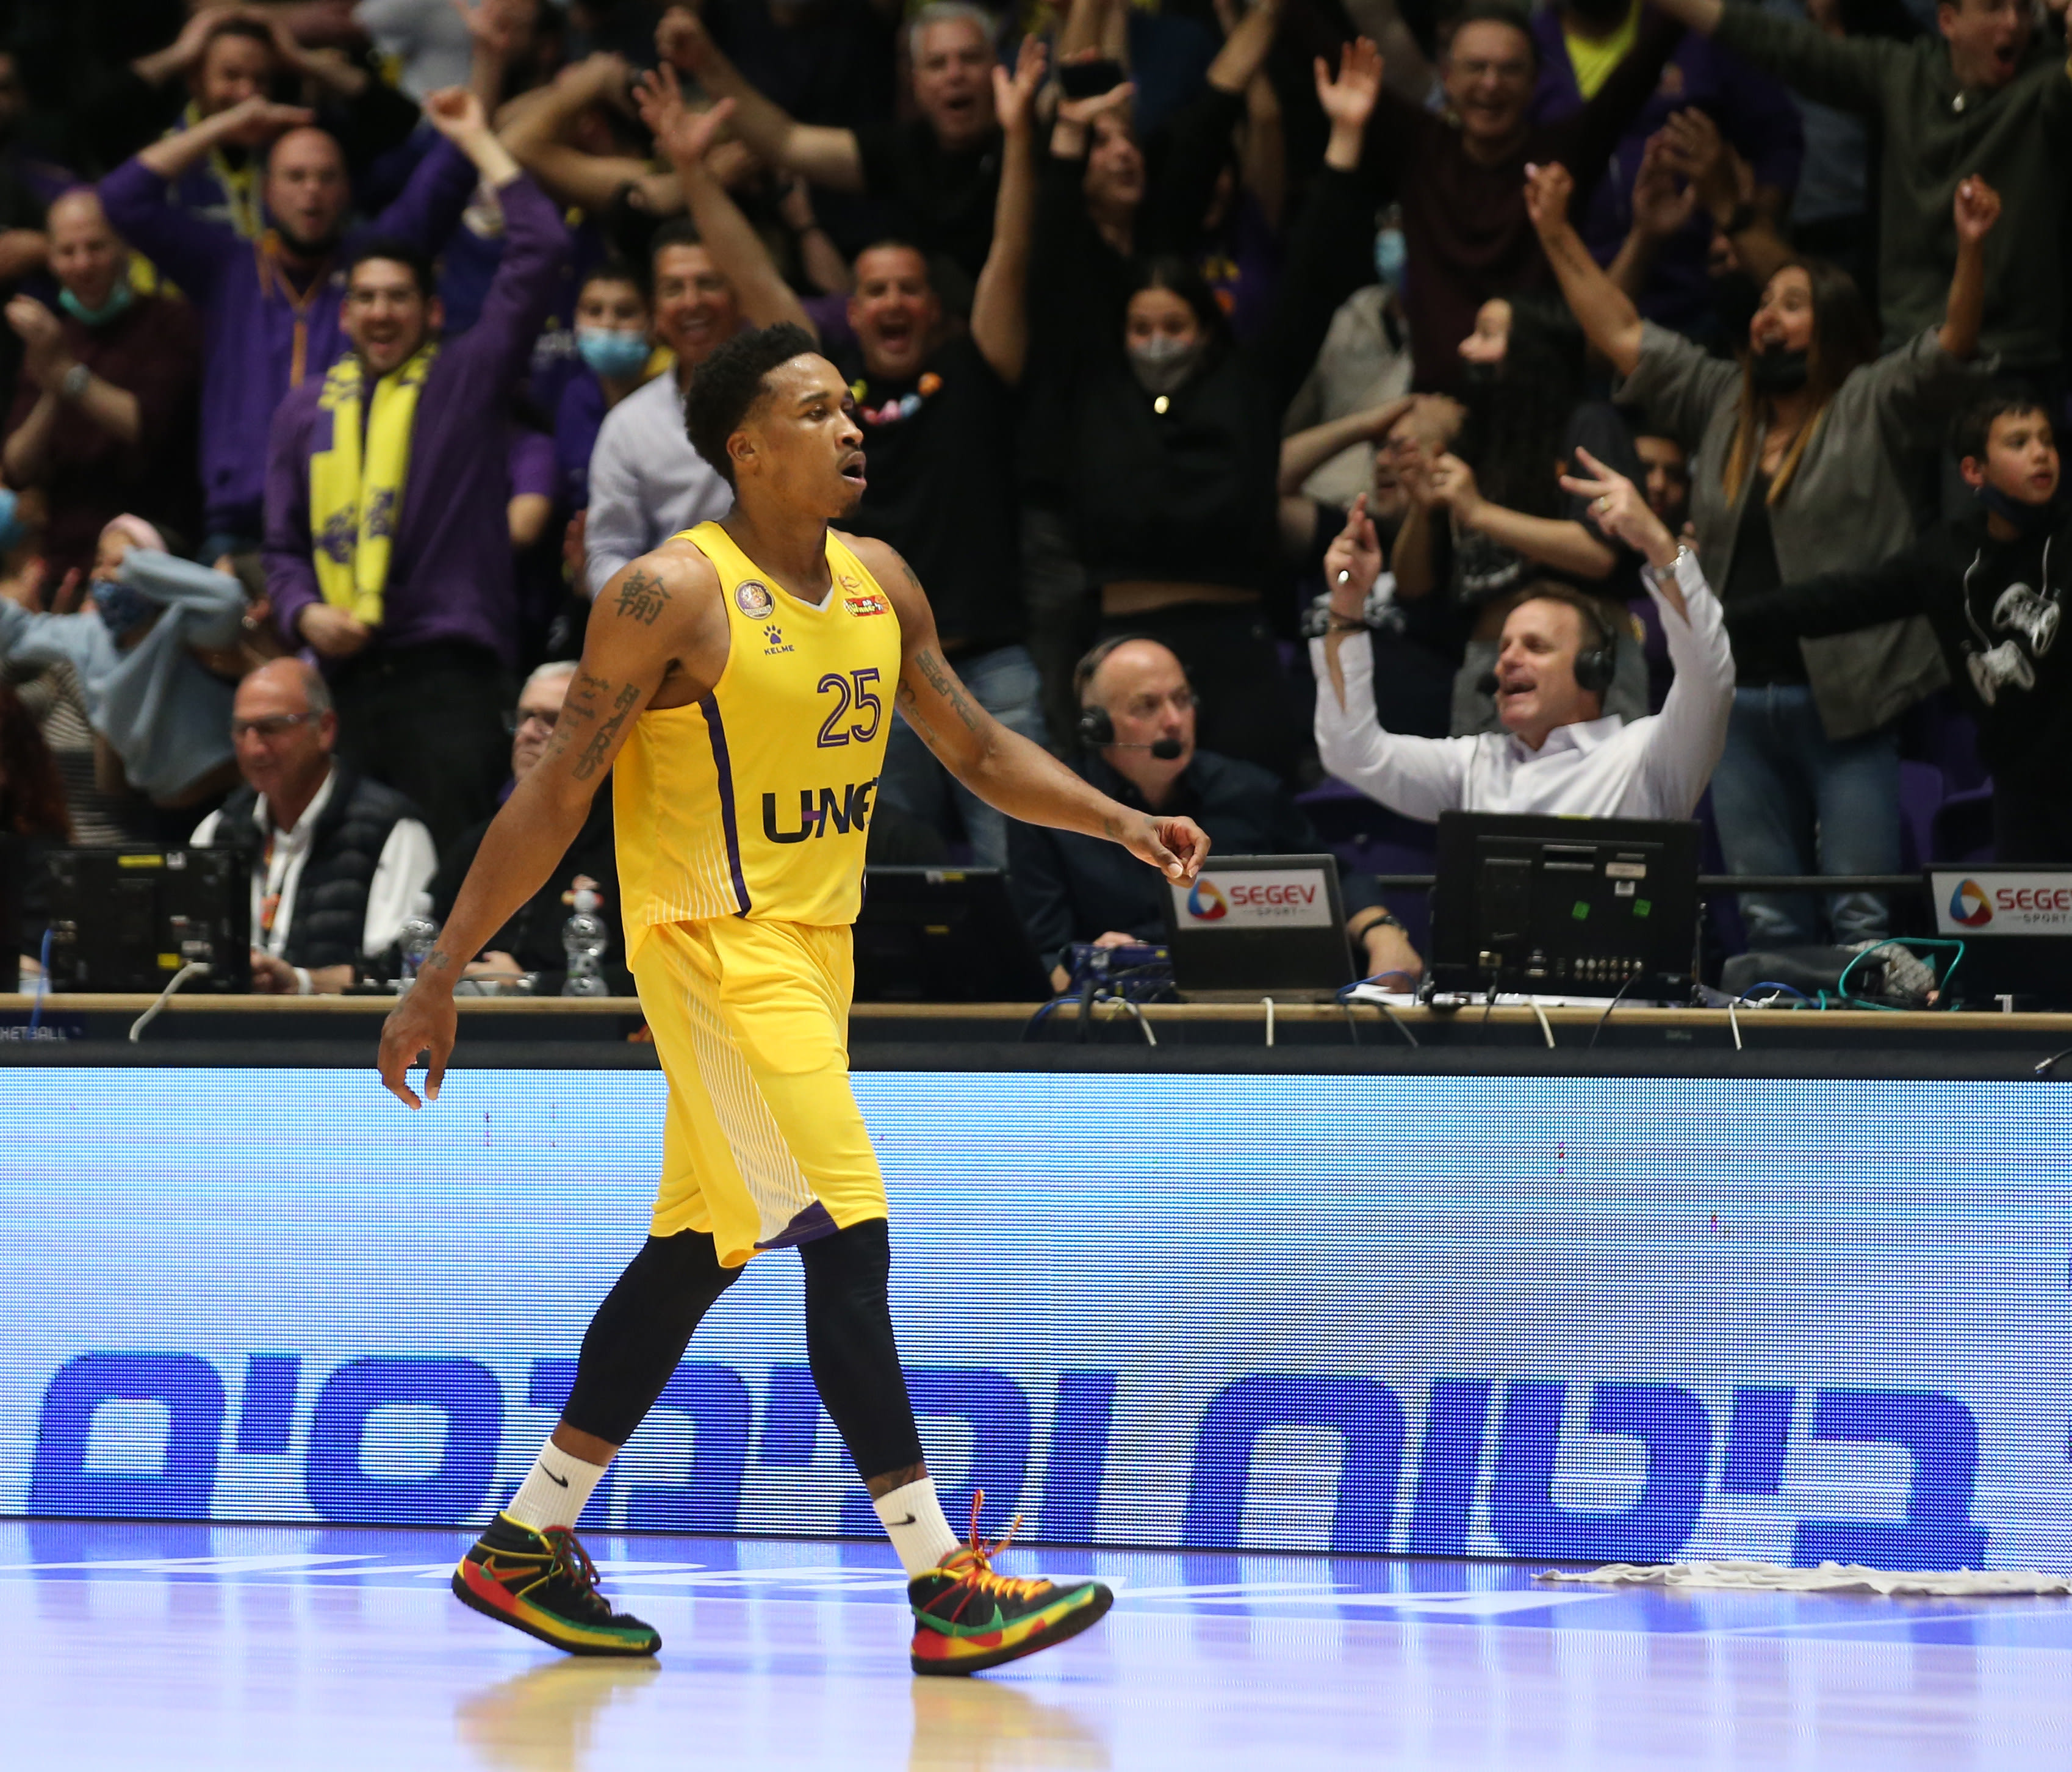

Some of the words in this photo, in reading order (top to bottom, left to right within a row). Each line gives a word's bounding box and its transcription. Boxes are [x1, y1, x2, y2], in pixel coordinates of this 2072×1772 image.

[764, 644, 795, 655] KELME
[816, 667, 881, 748] 25
[1229, 884, 1317, 906] SEGEV
[1996, 888, 2072, 910] SEGE
[1257, 907, 1297, 917] SPORT
[2023, 913, 2068, 923] SPORT
[1184, 1374, 1990, 1570] ביטוח
